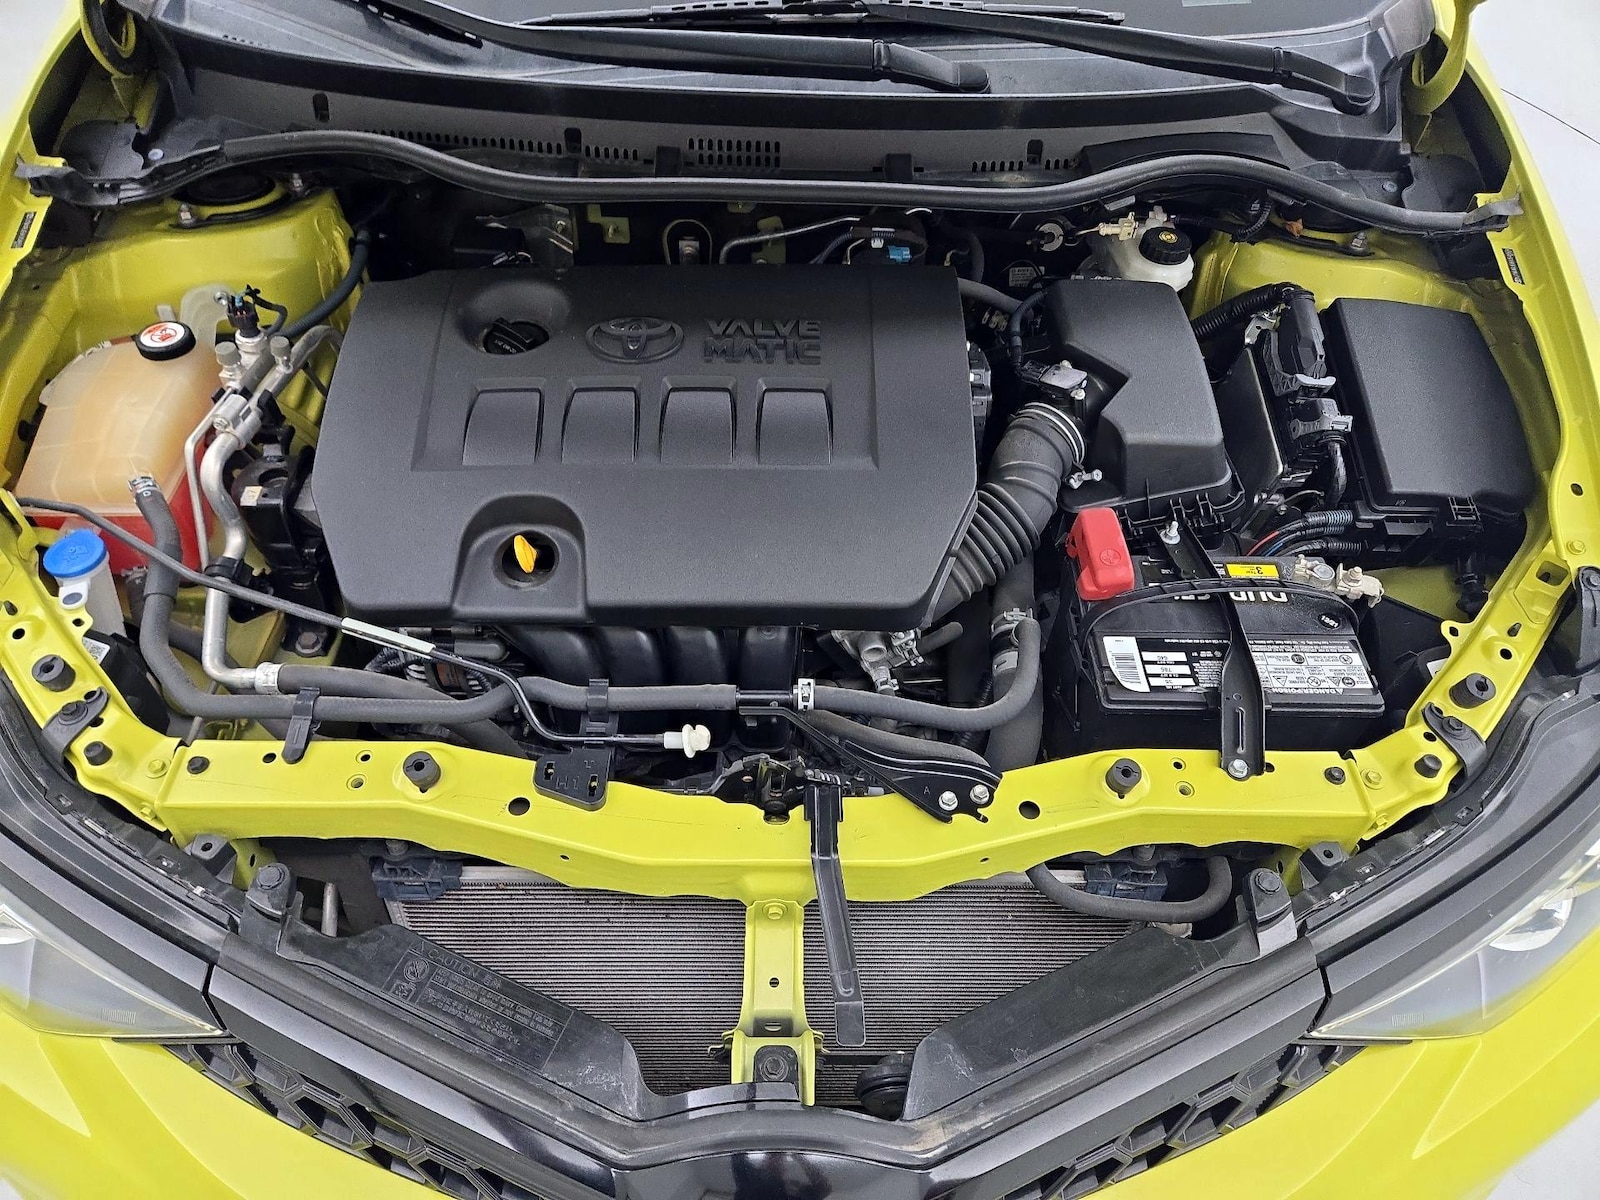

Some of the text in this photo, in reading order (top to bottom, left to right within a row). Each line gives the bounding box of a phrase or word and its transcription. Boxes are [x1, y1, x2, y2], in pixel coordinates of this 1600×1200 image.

[703, 319, 820, 337] VALVE
[703, 338, 821, 364] MATIC
[1256, 566, 1264, 574] 3
[923, 786, 930, 795] A
[428, 948, 480, 978] CAUTION
